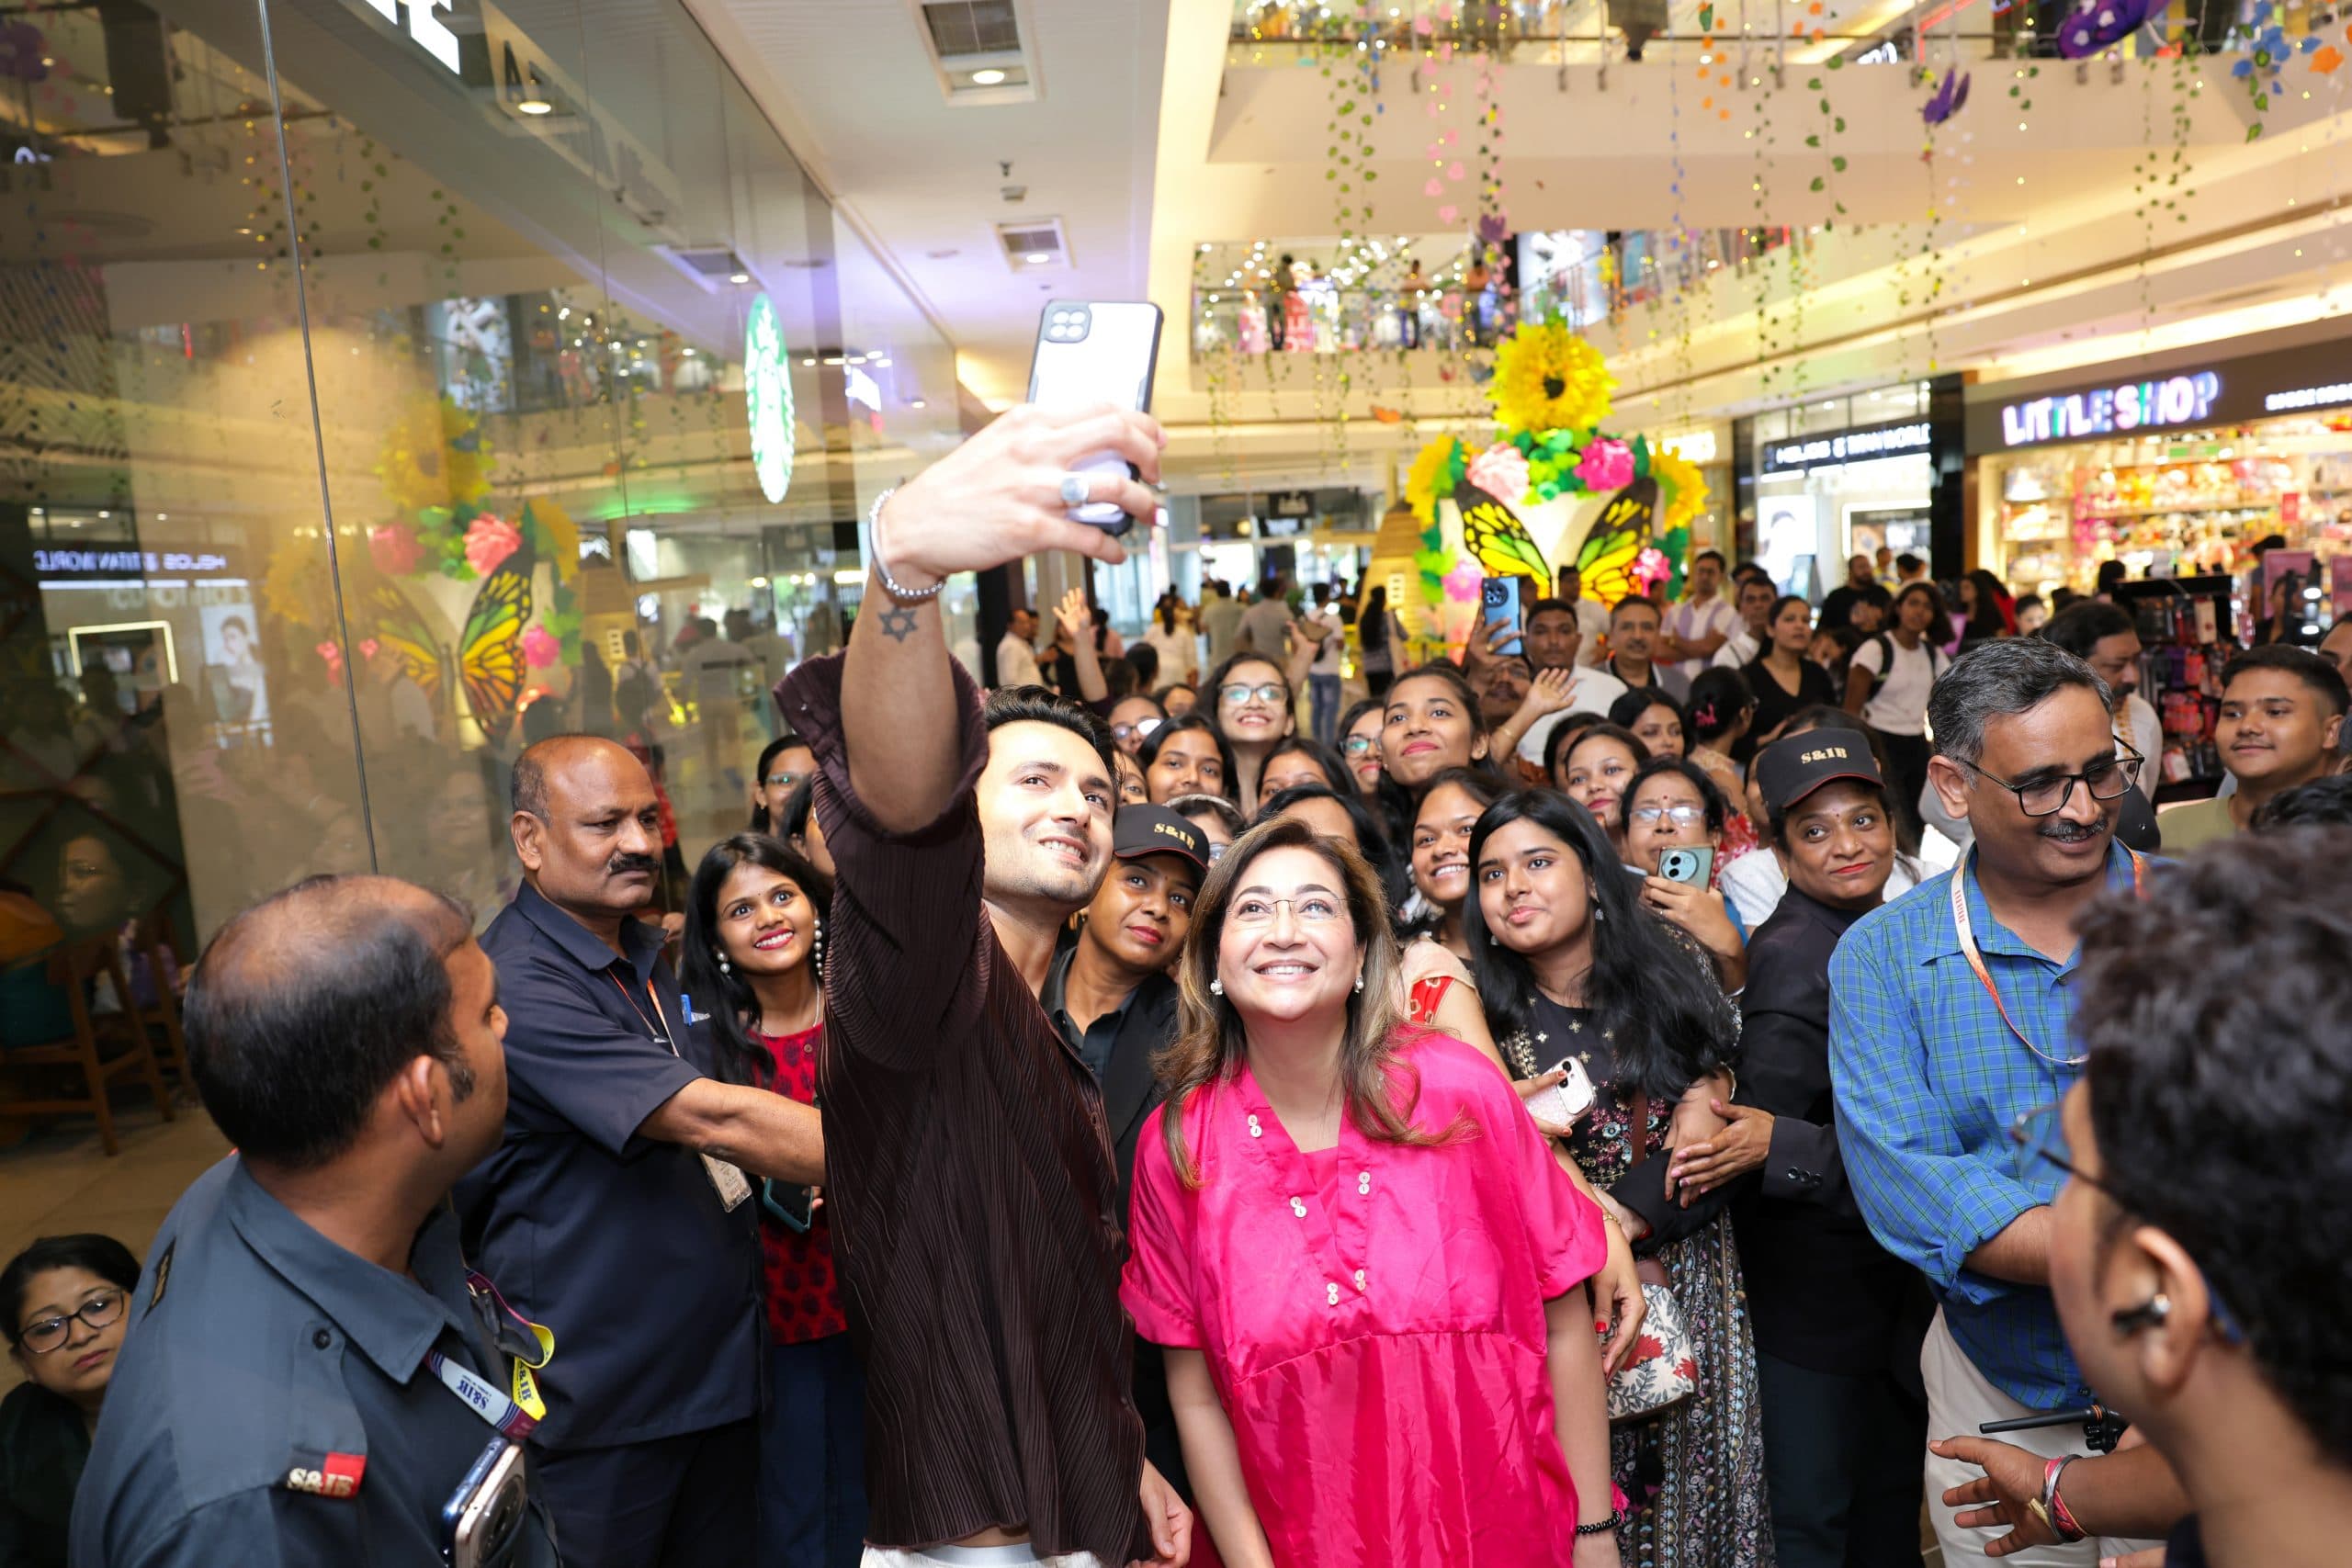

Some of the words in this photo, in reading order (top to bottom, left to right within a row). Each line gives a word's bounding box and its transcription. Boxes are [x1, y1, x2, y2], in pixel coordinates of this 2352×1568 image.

[2002, 389, 2113, 446] LITTLE
[2114, 371, 2221, 430] SHOP
[1801, 747, 1848, 764] S&IB
[1154, 823, 1194, 850] S&IB
[457, 1379, 490, 1410] S&IB
[287, 1467, 356, 1496] S&IB
